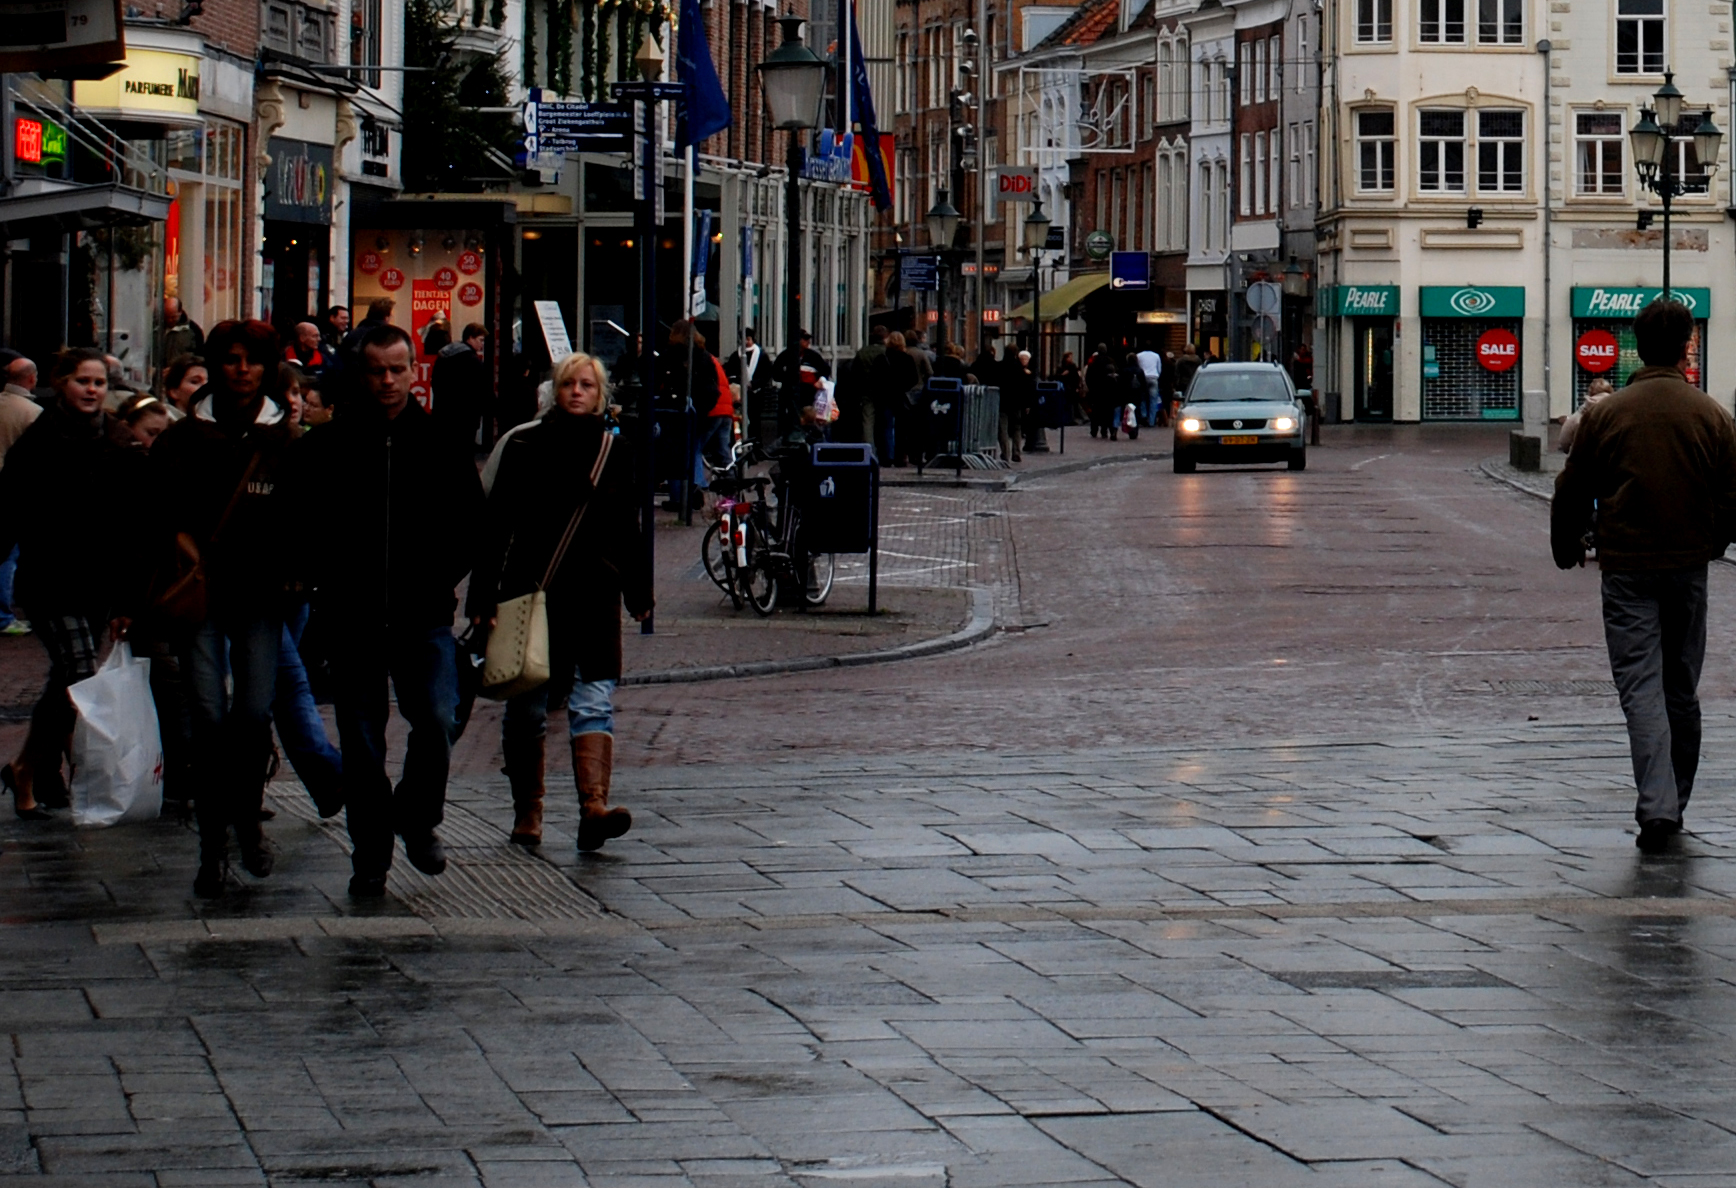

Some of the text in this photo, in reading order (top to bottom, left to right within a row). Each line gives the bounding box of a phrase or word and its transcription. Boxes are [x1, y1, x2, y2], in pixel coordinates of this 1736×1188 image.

[71, 15, 88, 26] 79
[125, 80, 174, 97] PARFUMERIE
[1000, 174, 1031, 192] DiDi
[414, 290, 449, 299] TIENTJES
[1345, 287, 1389, 308] PEARLE
[1589, 289, 1644, 310] PEARLE
[413, 300, 450, 311] DAGEN
[1480, 343, 1515, 355] SALE
[1580, 345, 1615, 356] SALE
